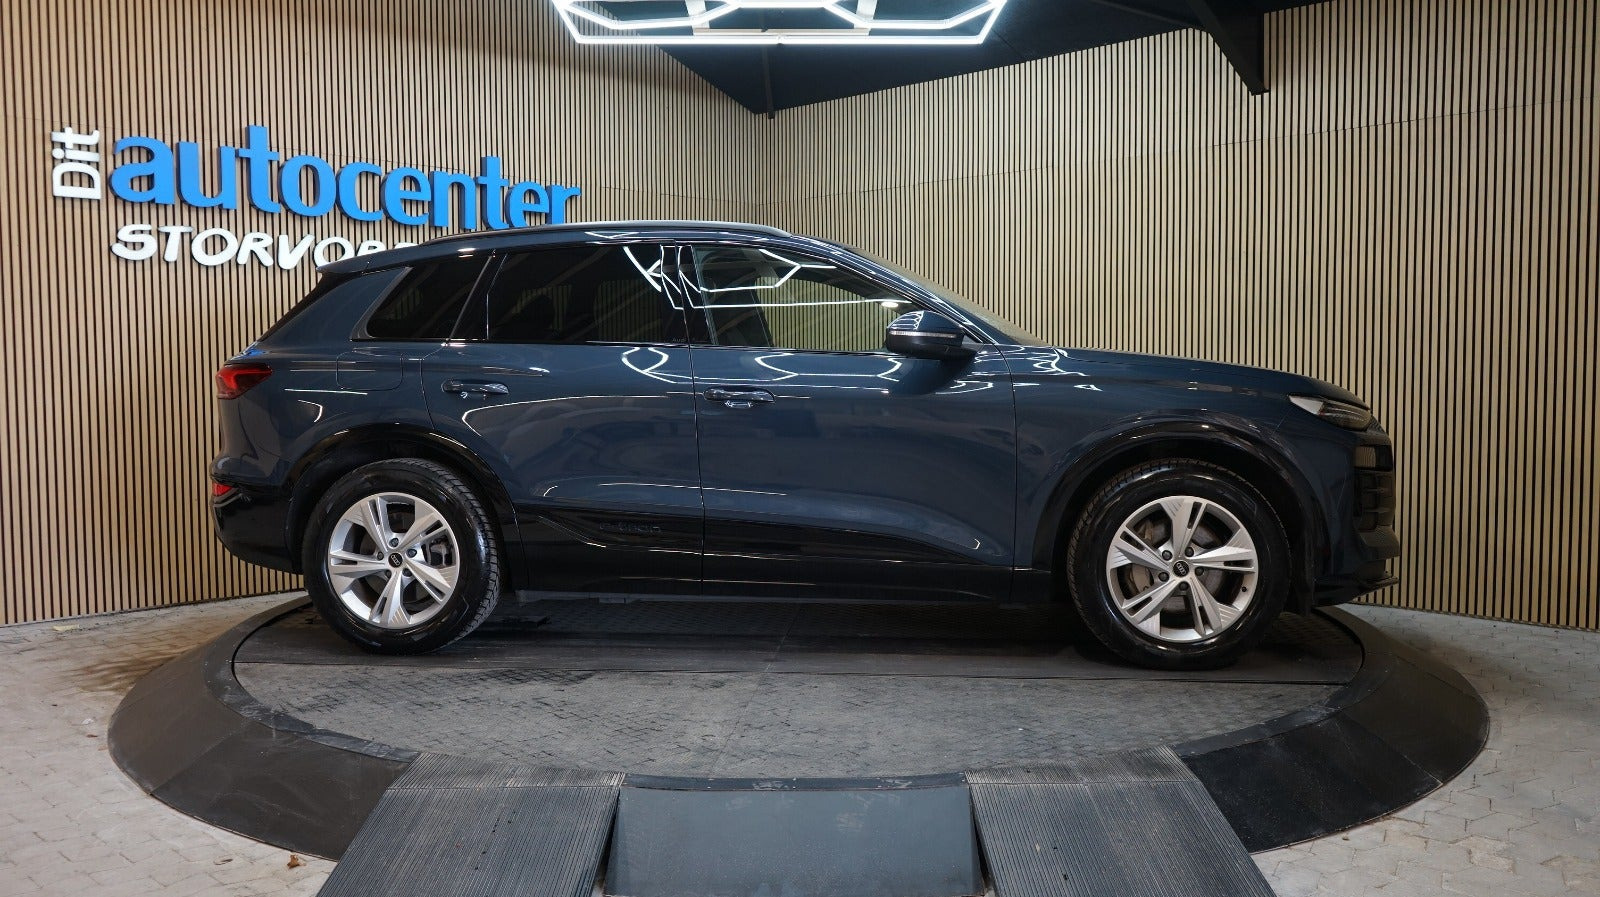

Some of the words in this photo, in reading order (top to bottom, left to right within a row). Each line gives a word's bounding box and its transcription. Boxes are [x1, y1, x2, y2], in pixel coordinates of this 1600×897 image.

[52, 126, 102, 200] Dit
[109, 125, 581, 231] autocenter
[110, 223, 419, 270] STORVO
